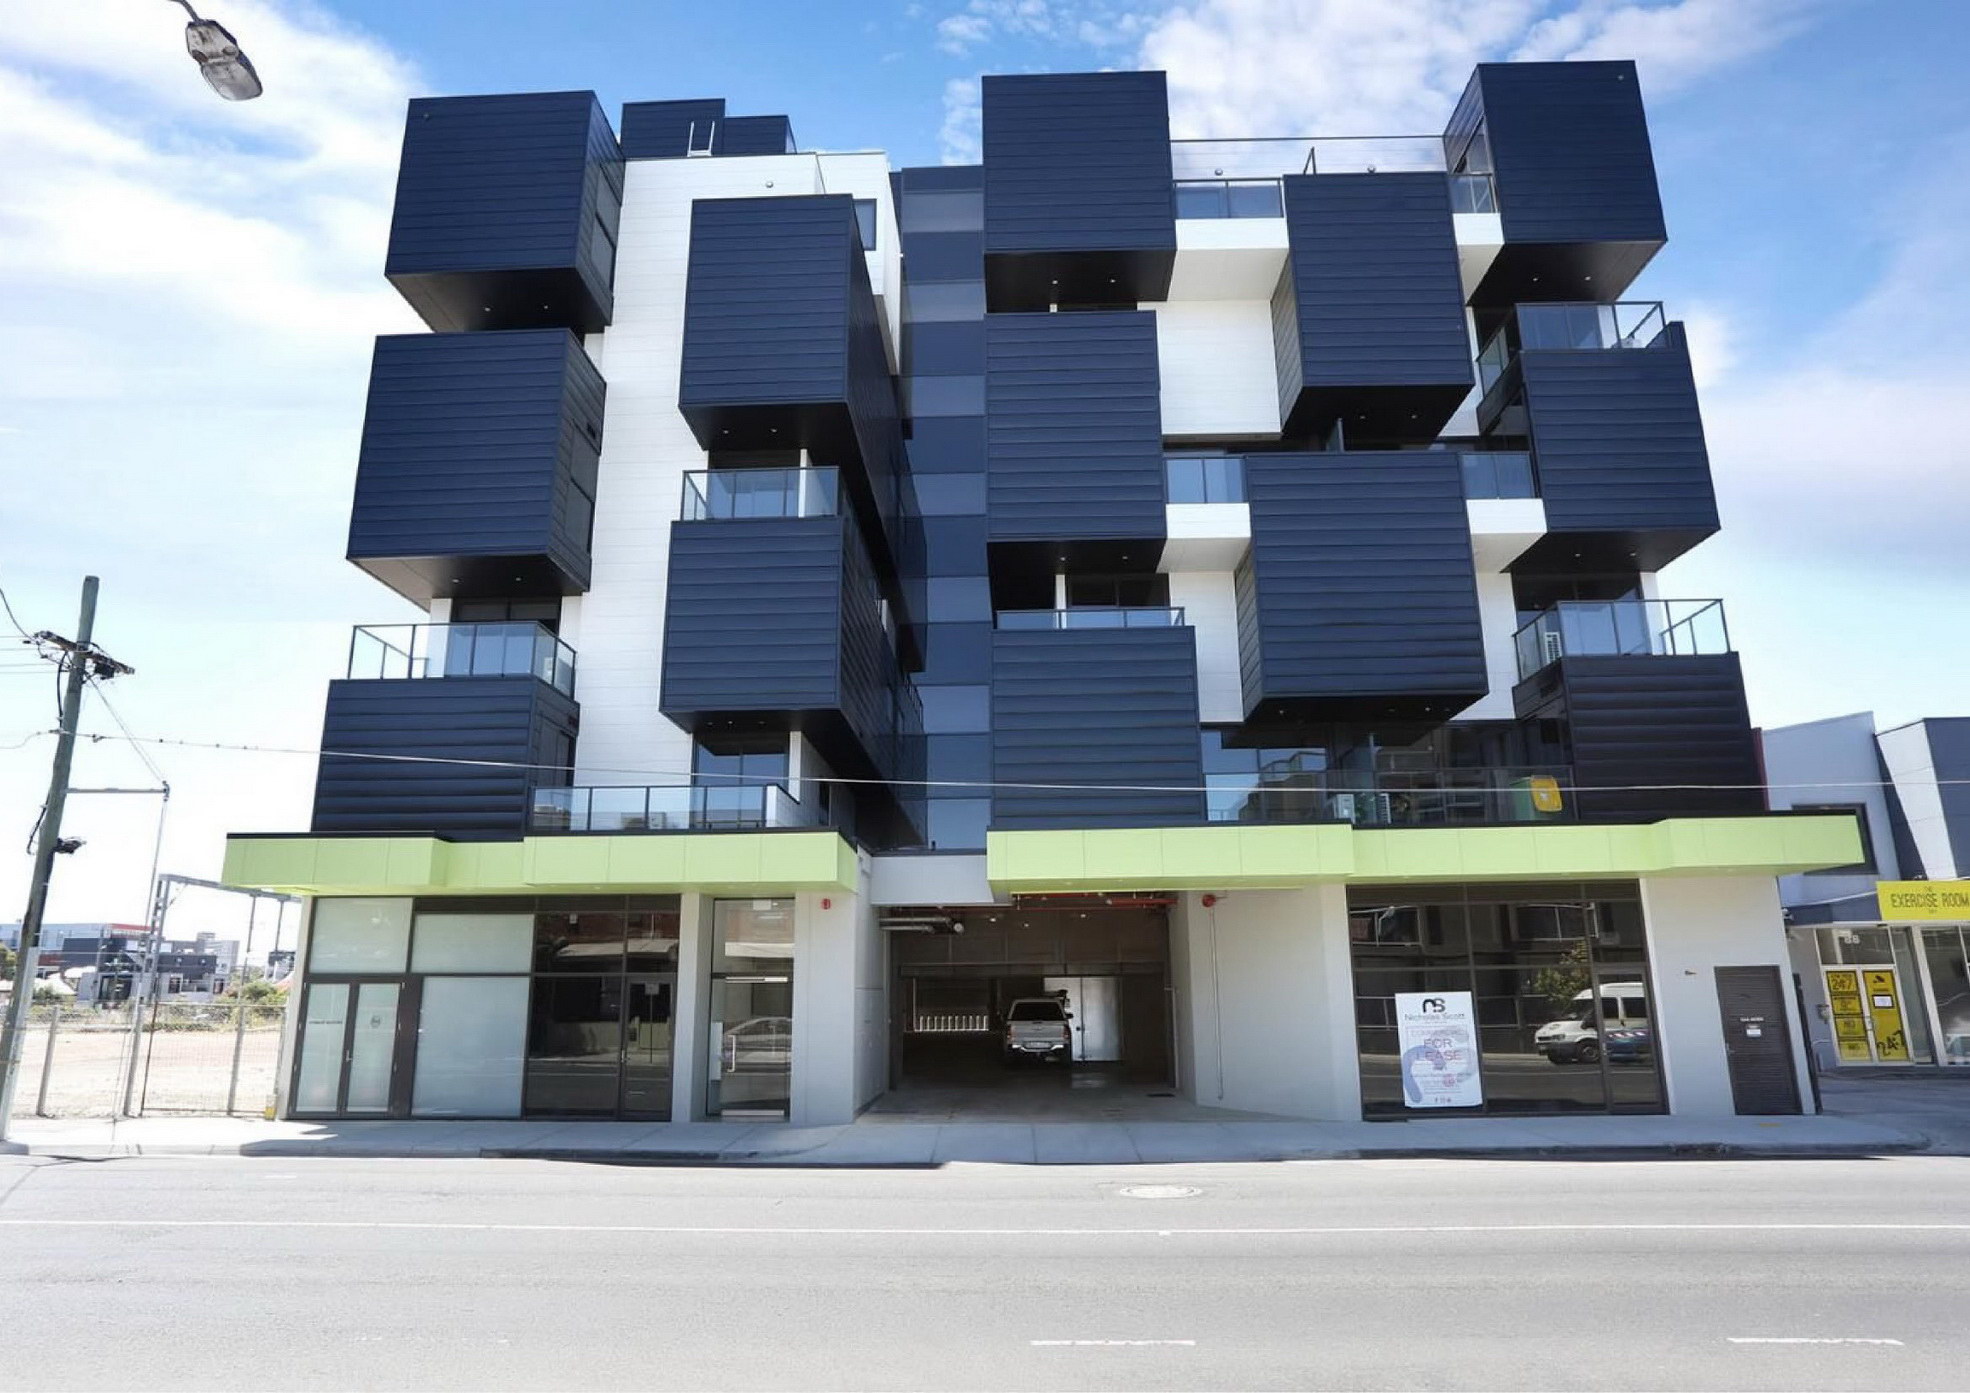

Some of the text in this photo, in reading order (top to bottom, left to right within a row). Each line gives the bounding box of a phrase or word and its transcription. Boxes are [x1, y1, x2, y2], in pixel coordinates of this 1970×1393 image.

[1890, 892, 1970, 908] EXERCISE ROOM
[1404, 1012, 1465, 1021] Nicholas Scott
[1423, 1038, 1453, 1049] FOR
[1416, 1050, 1463, 1061] LEASE
